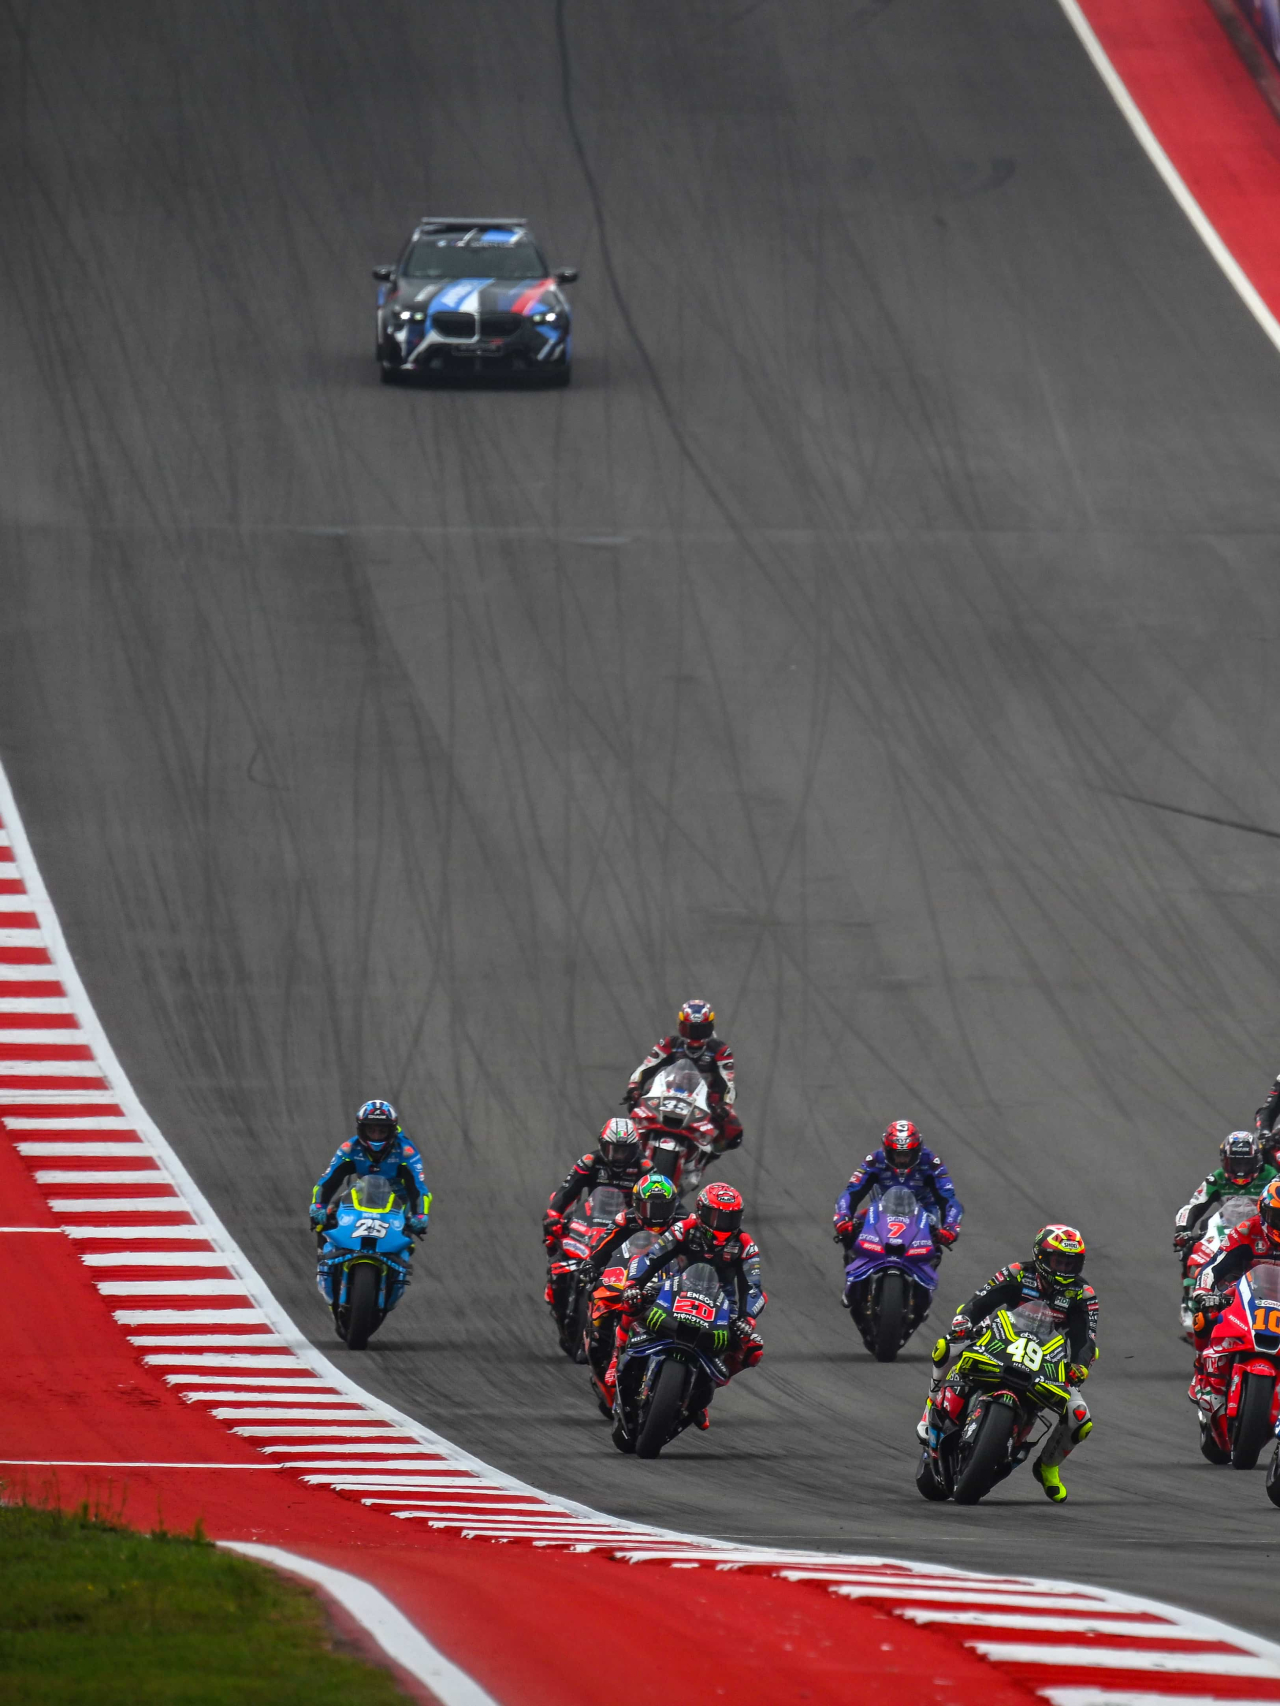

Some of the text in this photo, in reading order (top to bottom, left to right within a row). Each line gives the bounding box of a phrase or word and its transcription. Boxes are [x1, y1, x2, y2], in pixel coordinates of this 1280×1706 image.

[351, 1218, 389, 1238] 25
[887, 1222, 907, 1238] 7
[687, 1291, 714, 1307] ENEOS
[673, 1297, 716, 1322] 20
[673, 1312, 710, 1329] MONSTER
[1020, 1331, 1040, 1343] ebay
[1006, 1337, 1044, 1372] 49
